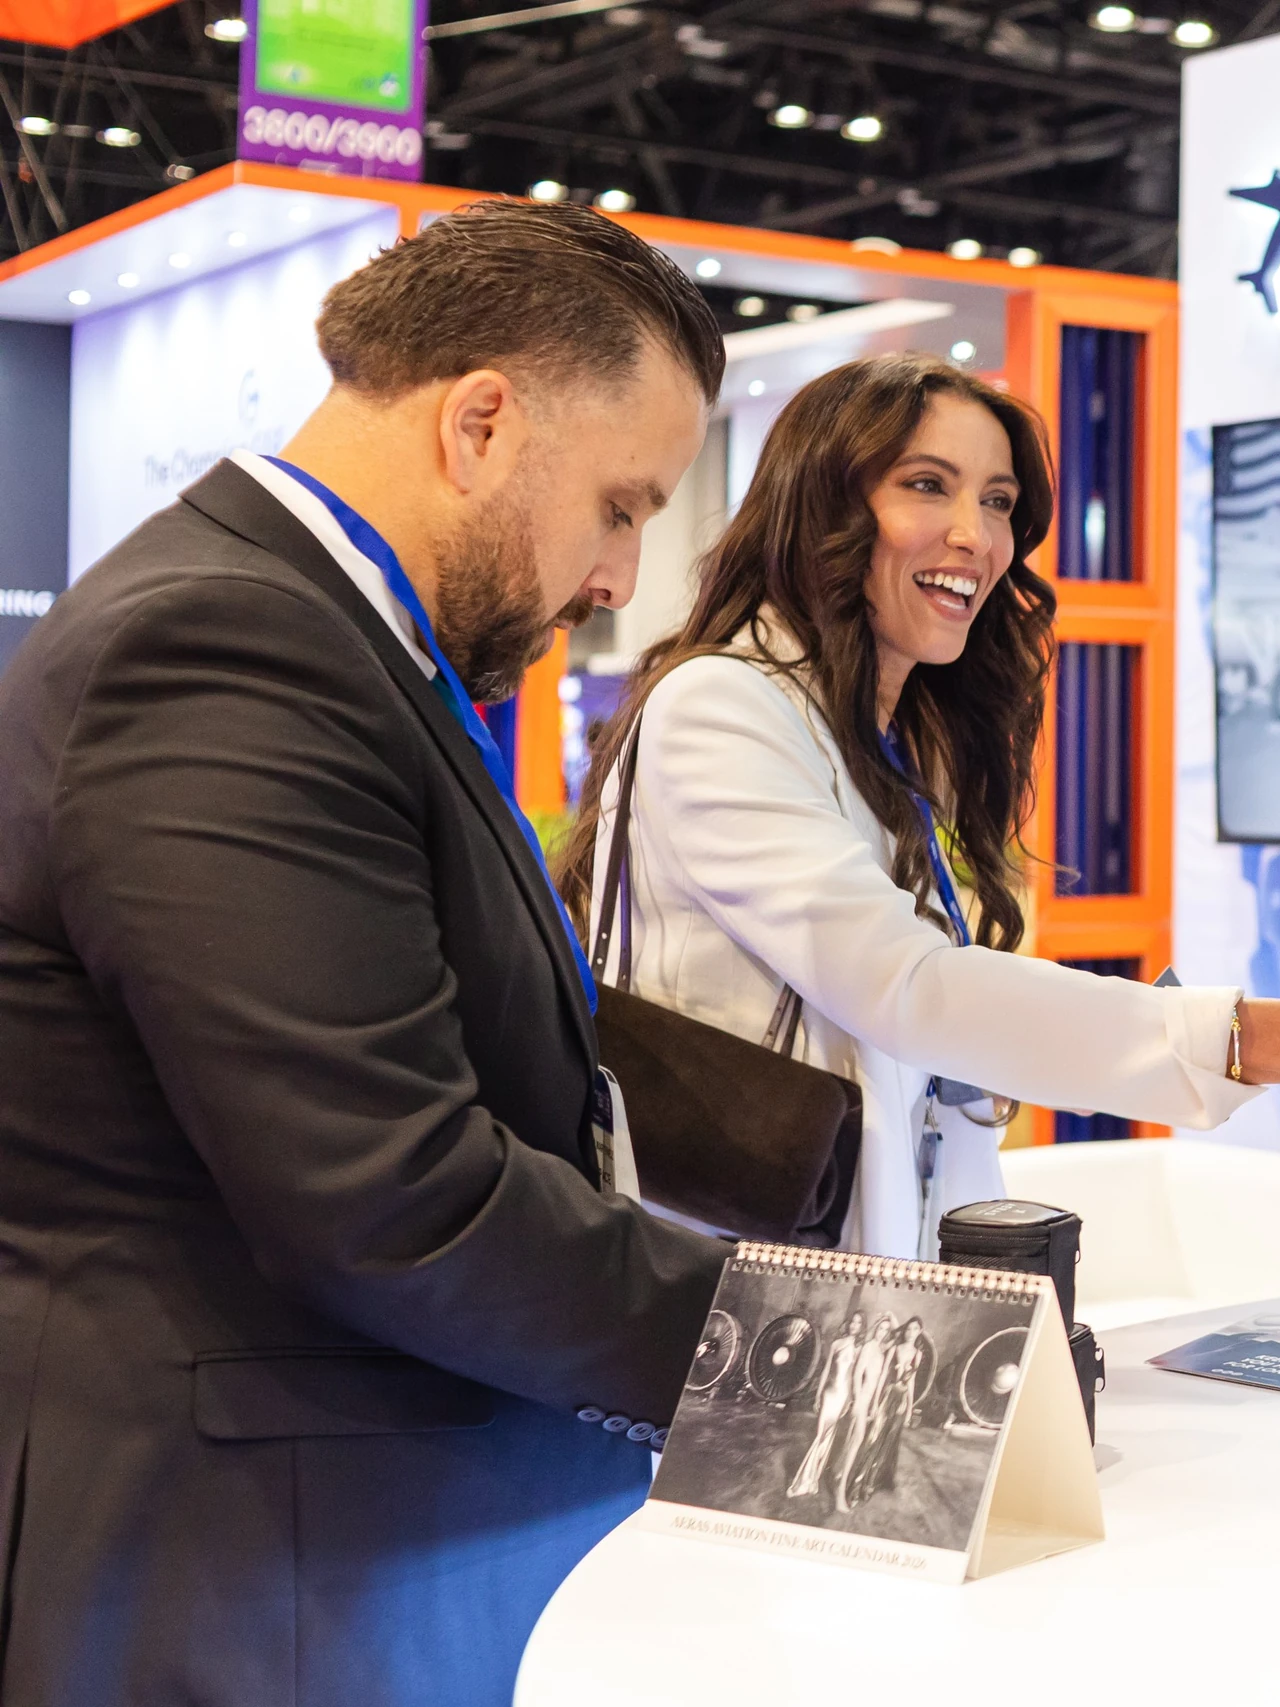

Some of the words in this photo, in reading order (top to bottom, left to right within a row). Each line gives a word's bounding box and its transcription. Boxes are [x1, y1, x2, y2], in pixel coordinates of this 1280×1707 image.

[0, 588, 57, 617] ING
[671, 1515, 710, 1533] AERAS
[711, 1522, 769, 1543] AVIATION
[770, 1531, 801, 1548] FINE
[801, 1537, 828, 1553] ART
[829, 1541, 900, 1566] CALENDAR
